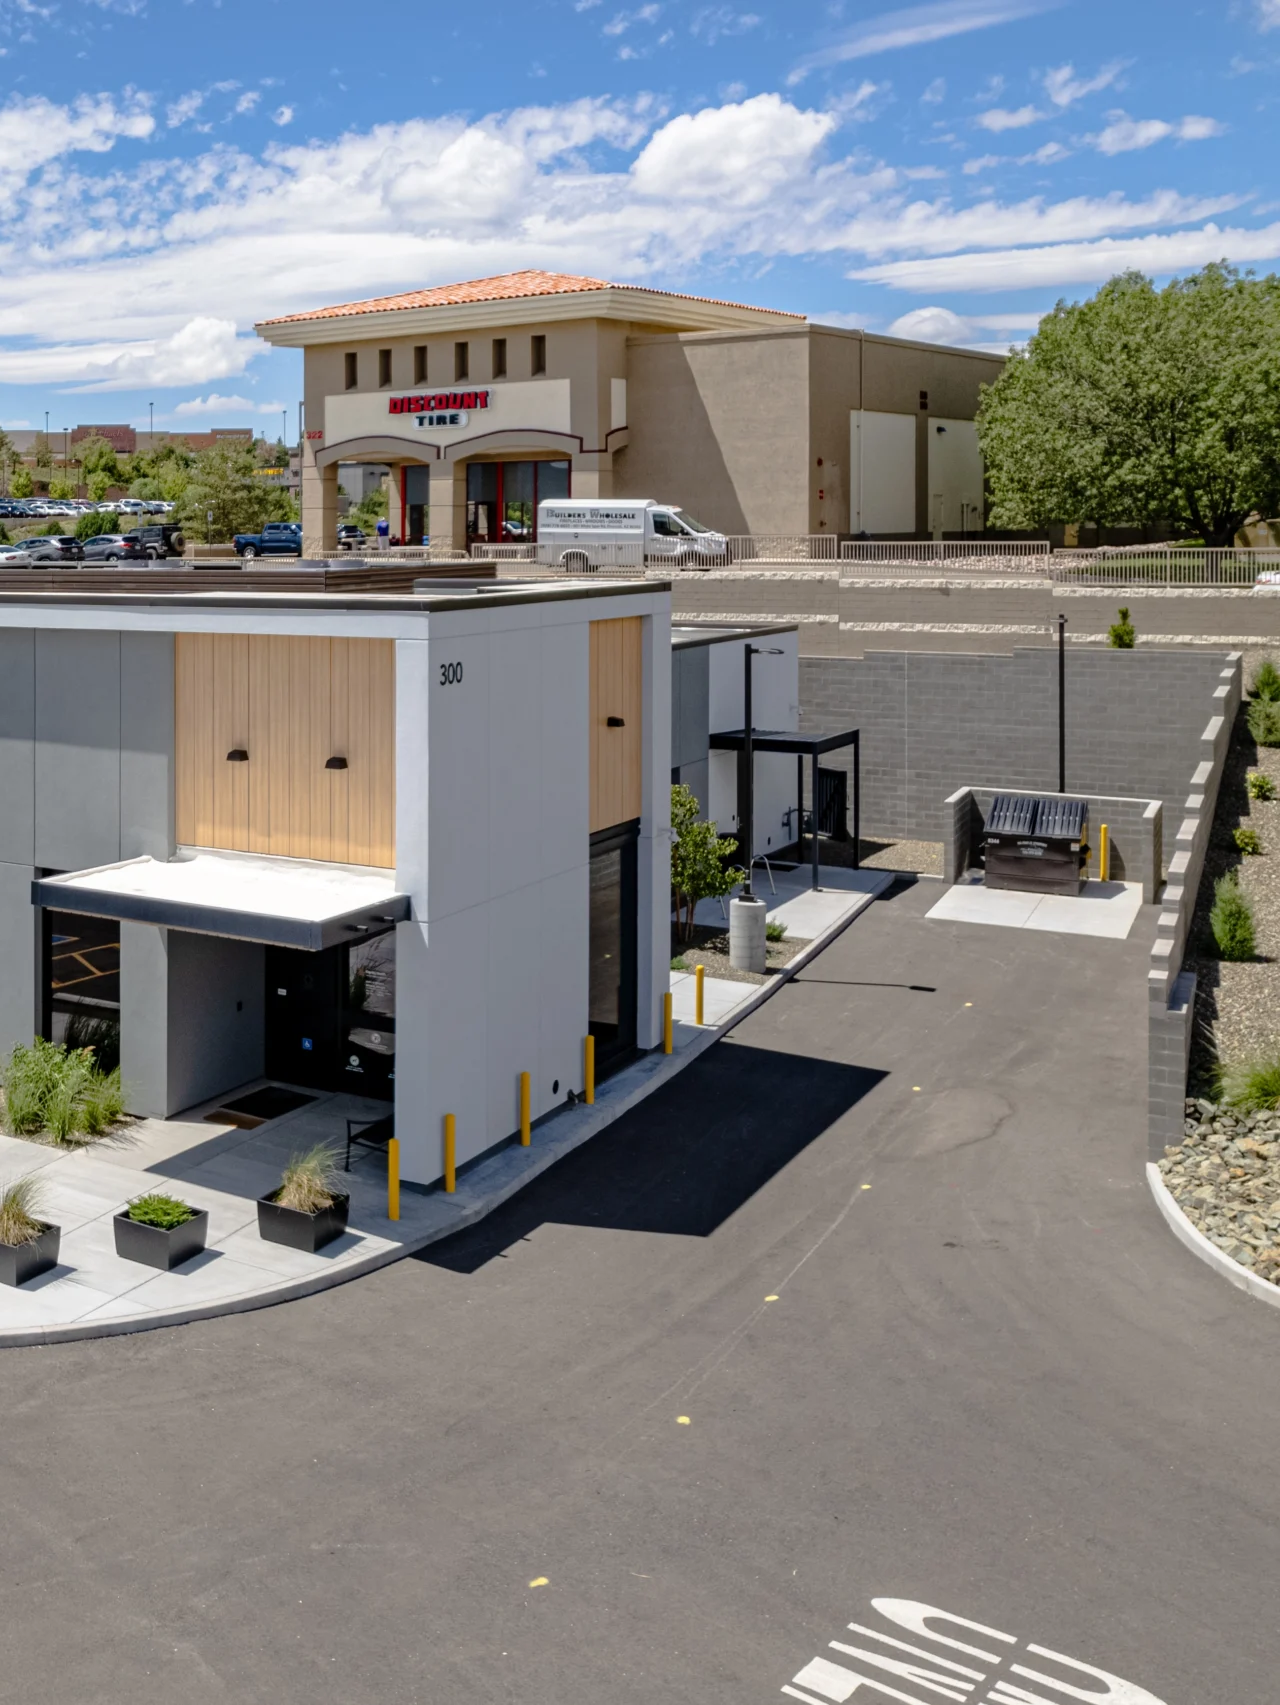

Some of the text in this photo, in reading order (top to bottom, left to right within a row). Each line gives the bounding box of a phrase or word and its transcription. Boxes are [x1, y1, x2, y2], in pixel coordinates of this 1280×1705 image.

[389, 391, 489, 414] DISCOUNT
[416, 414, 459, 426] TIRE
[546, 509, 636, 519] BUILDERS WHOLESALE
[440, 661, 463, 686] 300
